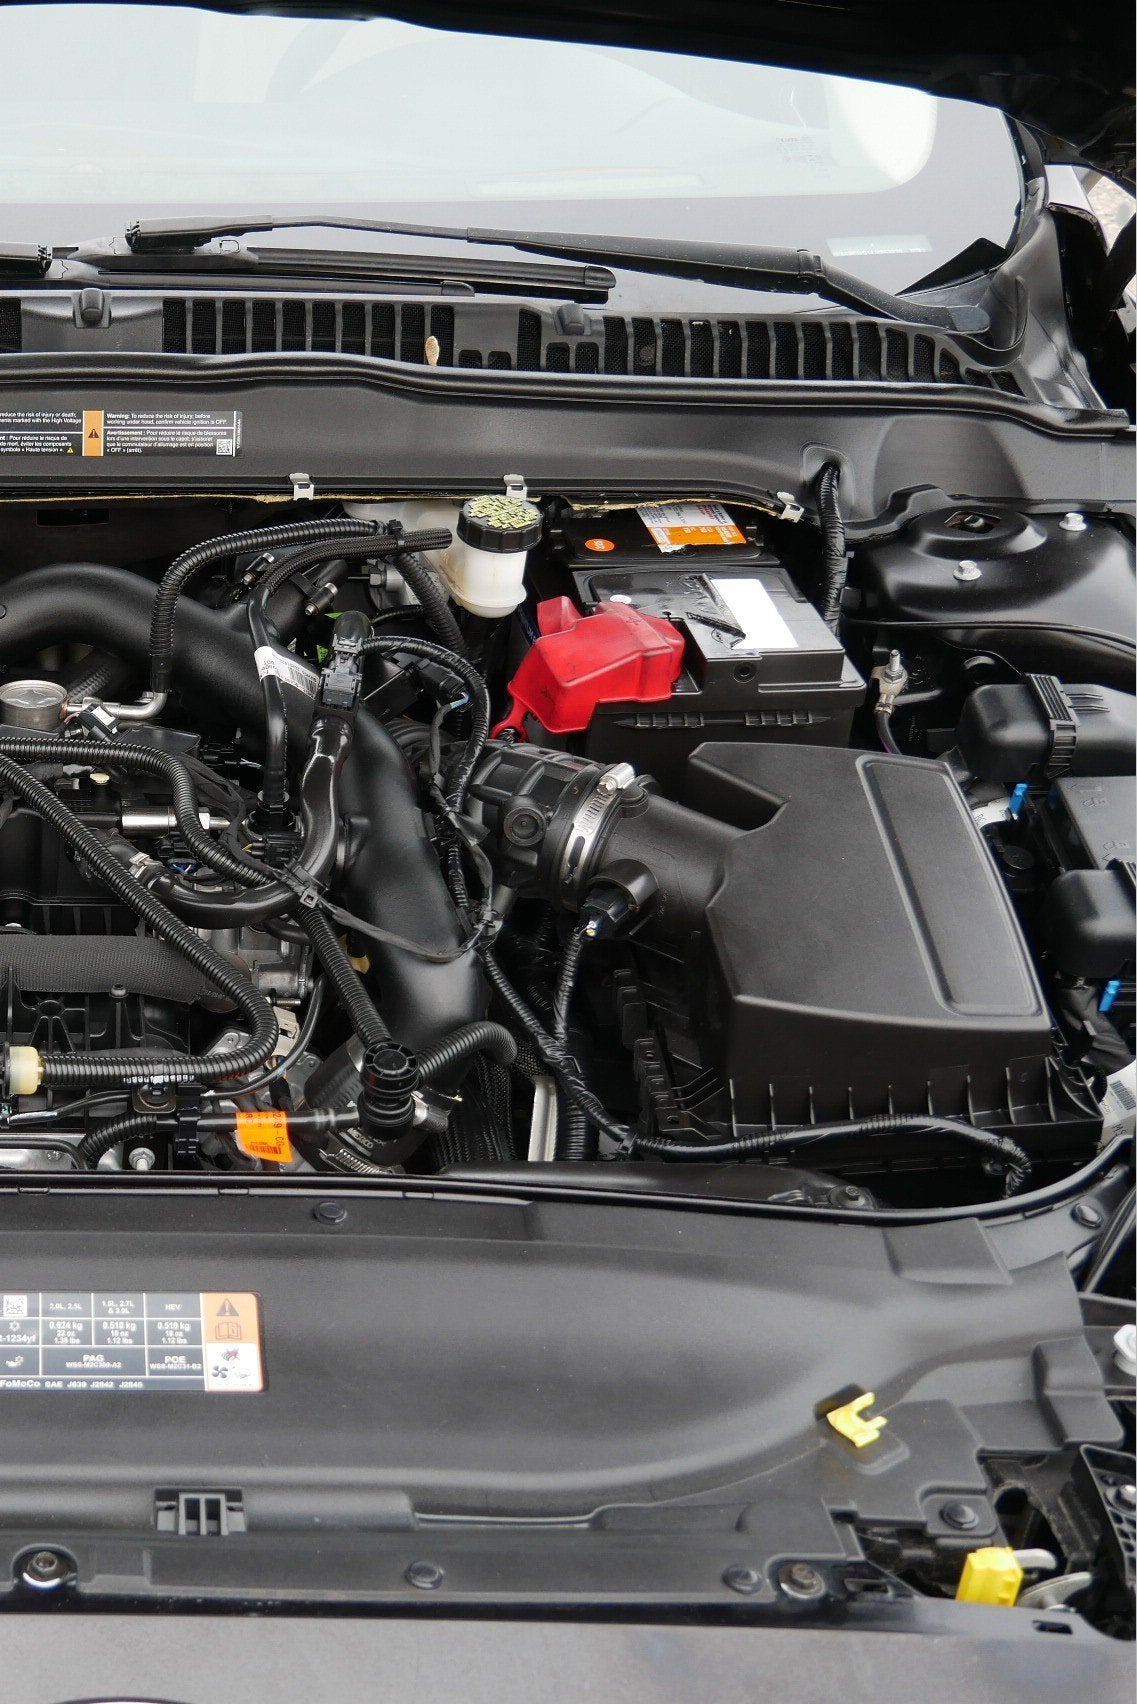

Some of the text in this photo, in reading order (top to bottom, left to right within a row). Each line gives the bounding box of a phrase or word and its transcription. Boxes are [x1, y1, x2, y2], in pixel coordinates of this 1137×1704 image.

[72, 1321, 83, 1331] kg
[102, 1321, 136, 1331] 0.510 kg
[157, 1321, 191, 1331] 0.510 kg
[83, 1354, 104, 1362] PAG
